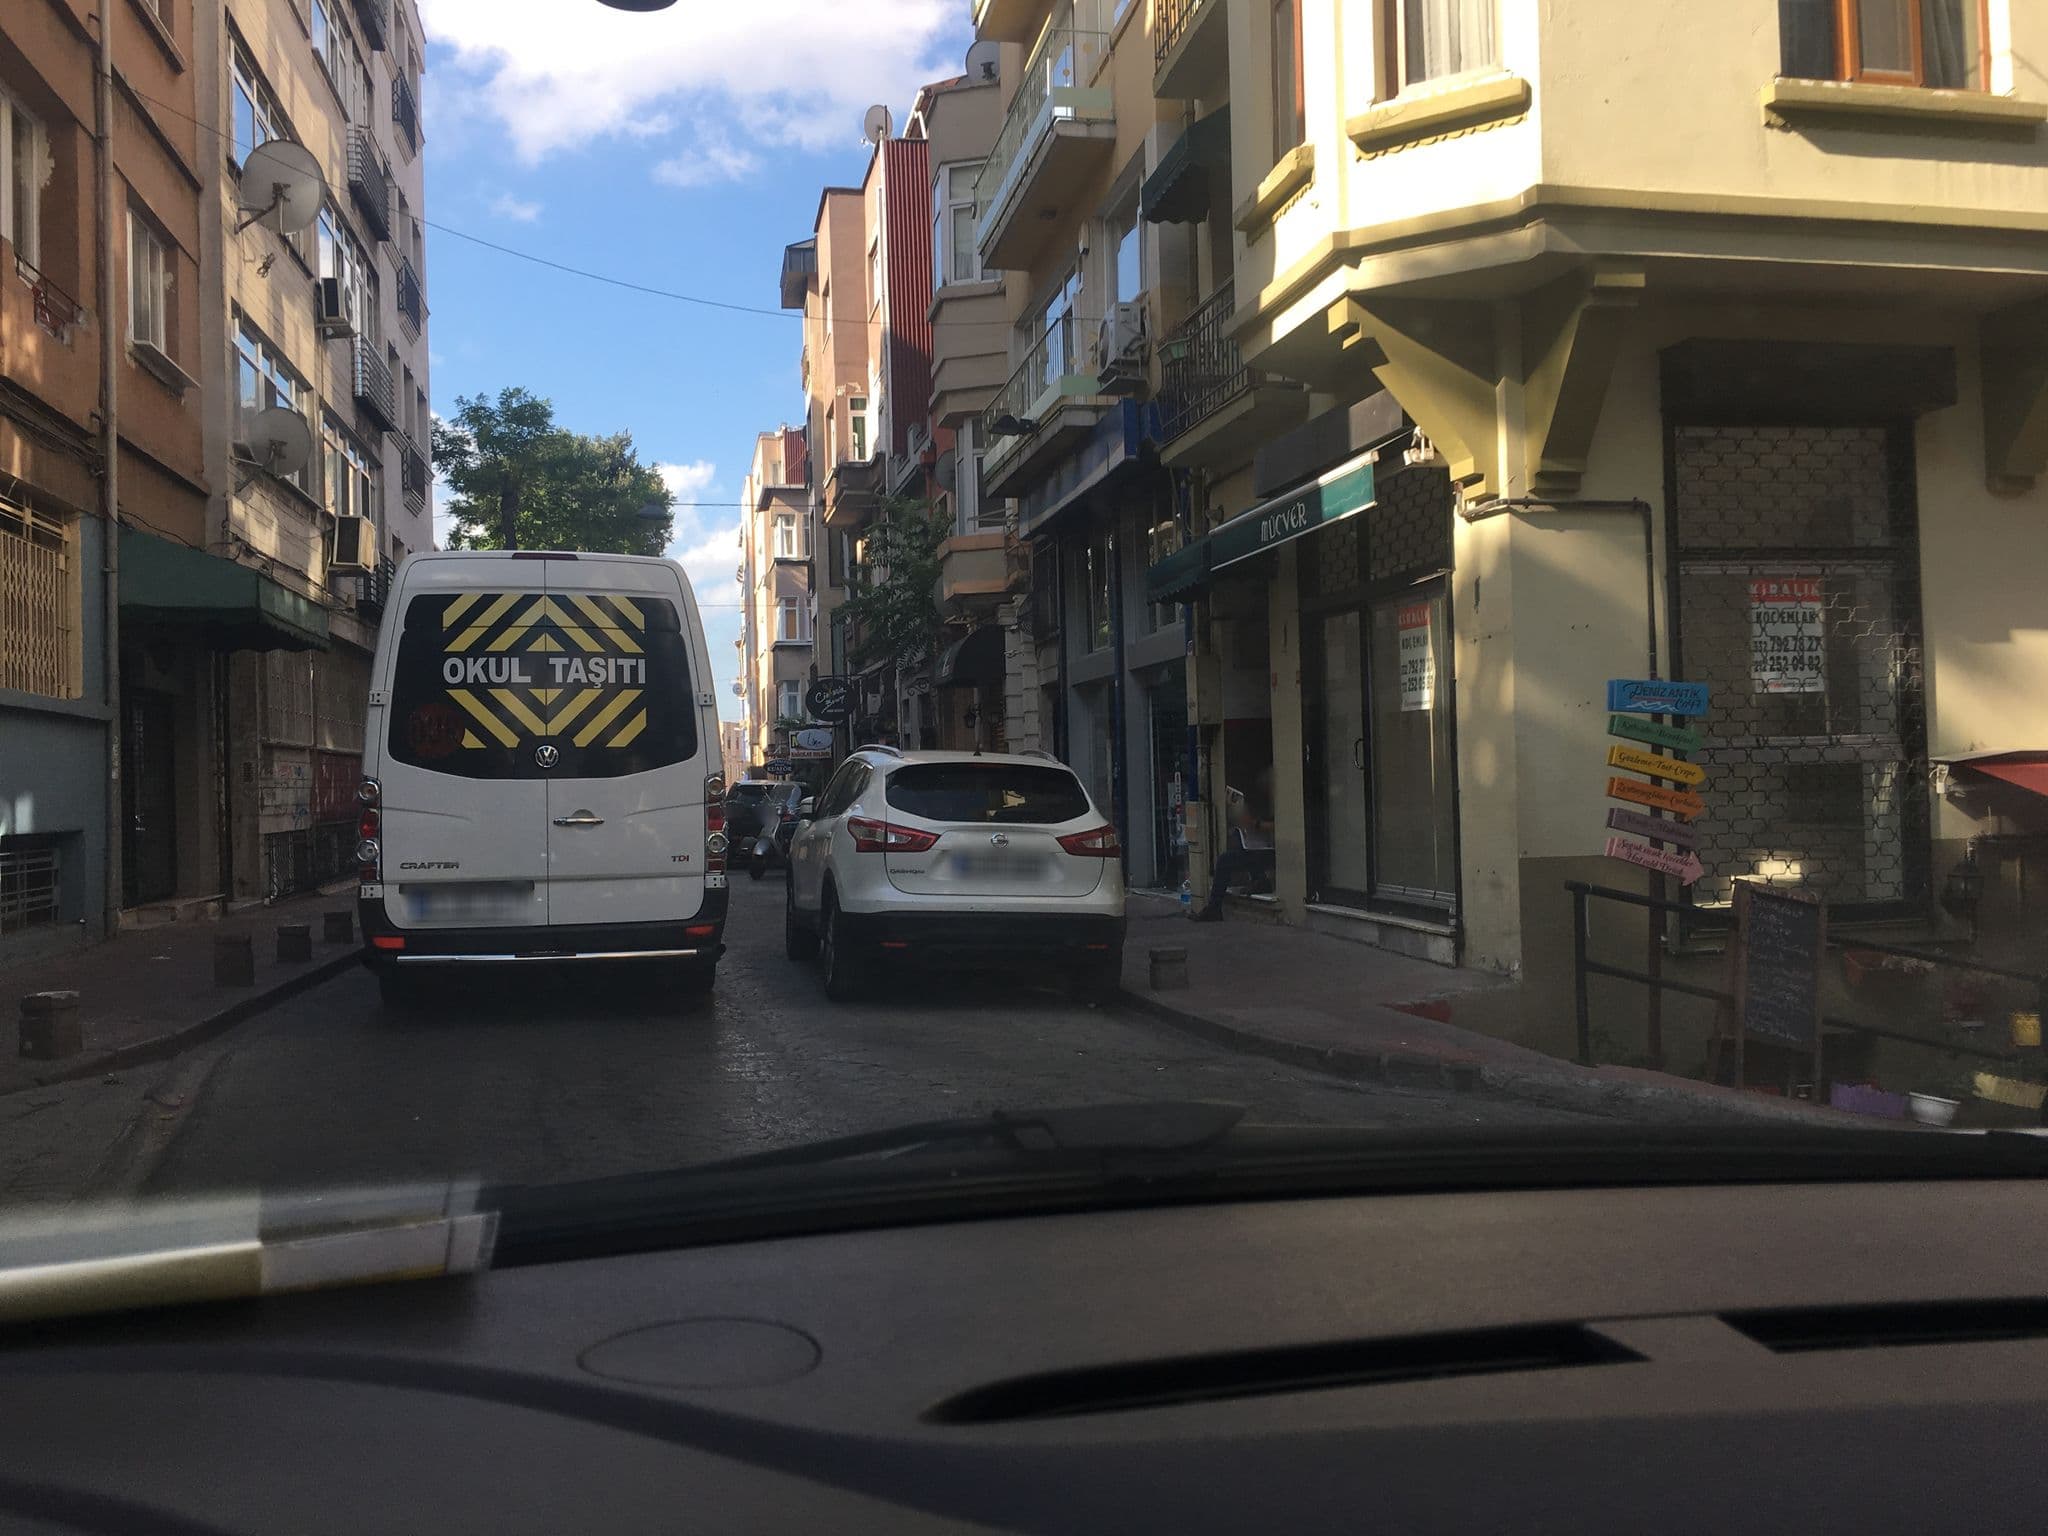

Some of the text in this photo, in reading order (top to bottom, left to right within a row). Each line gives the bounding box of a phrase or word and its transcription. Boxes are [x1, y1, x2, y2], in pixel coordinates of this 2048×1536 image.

[443, 657, 646, 688] OKUL TAŞITI
[400, 862, 460, 870] CRAFTER
